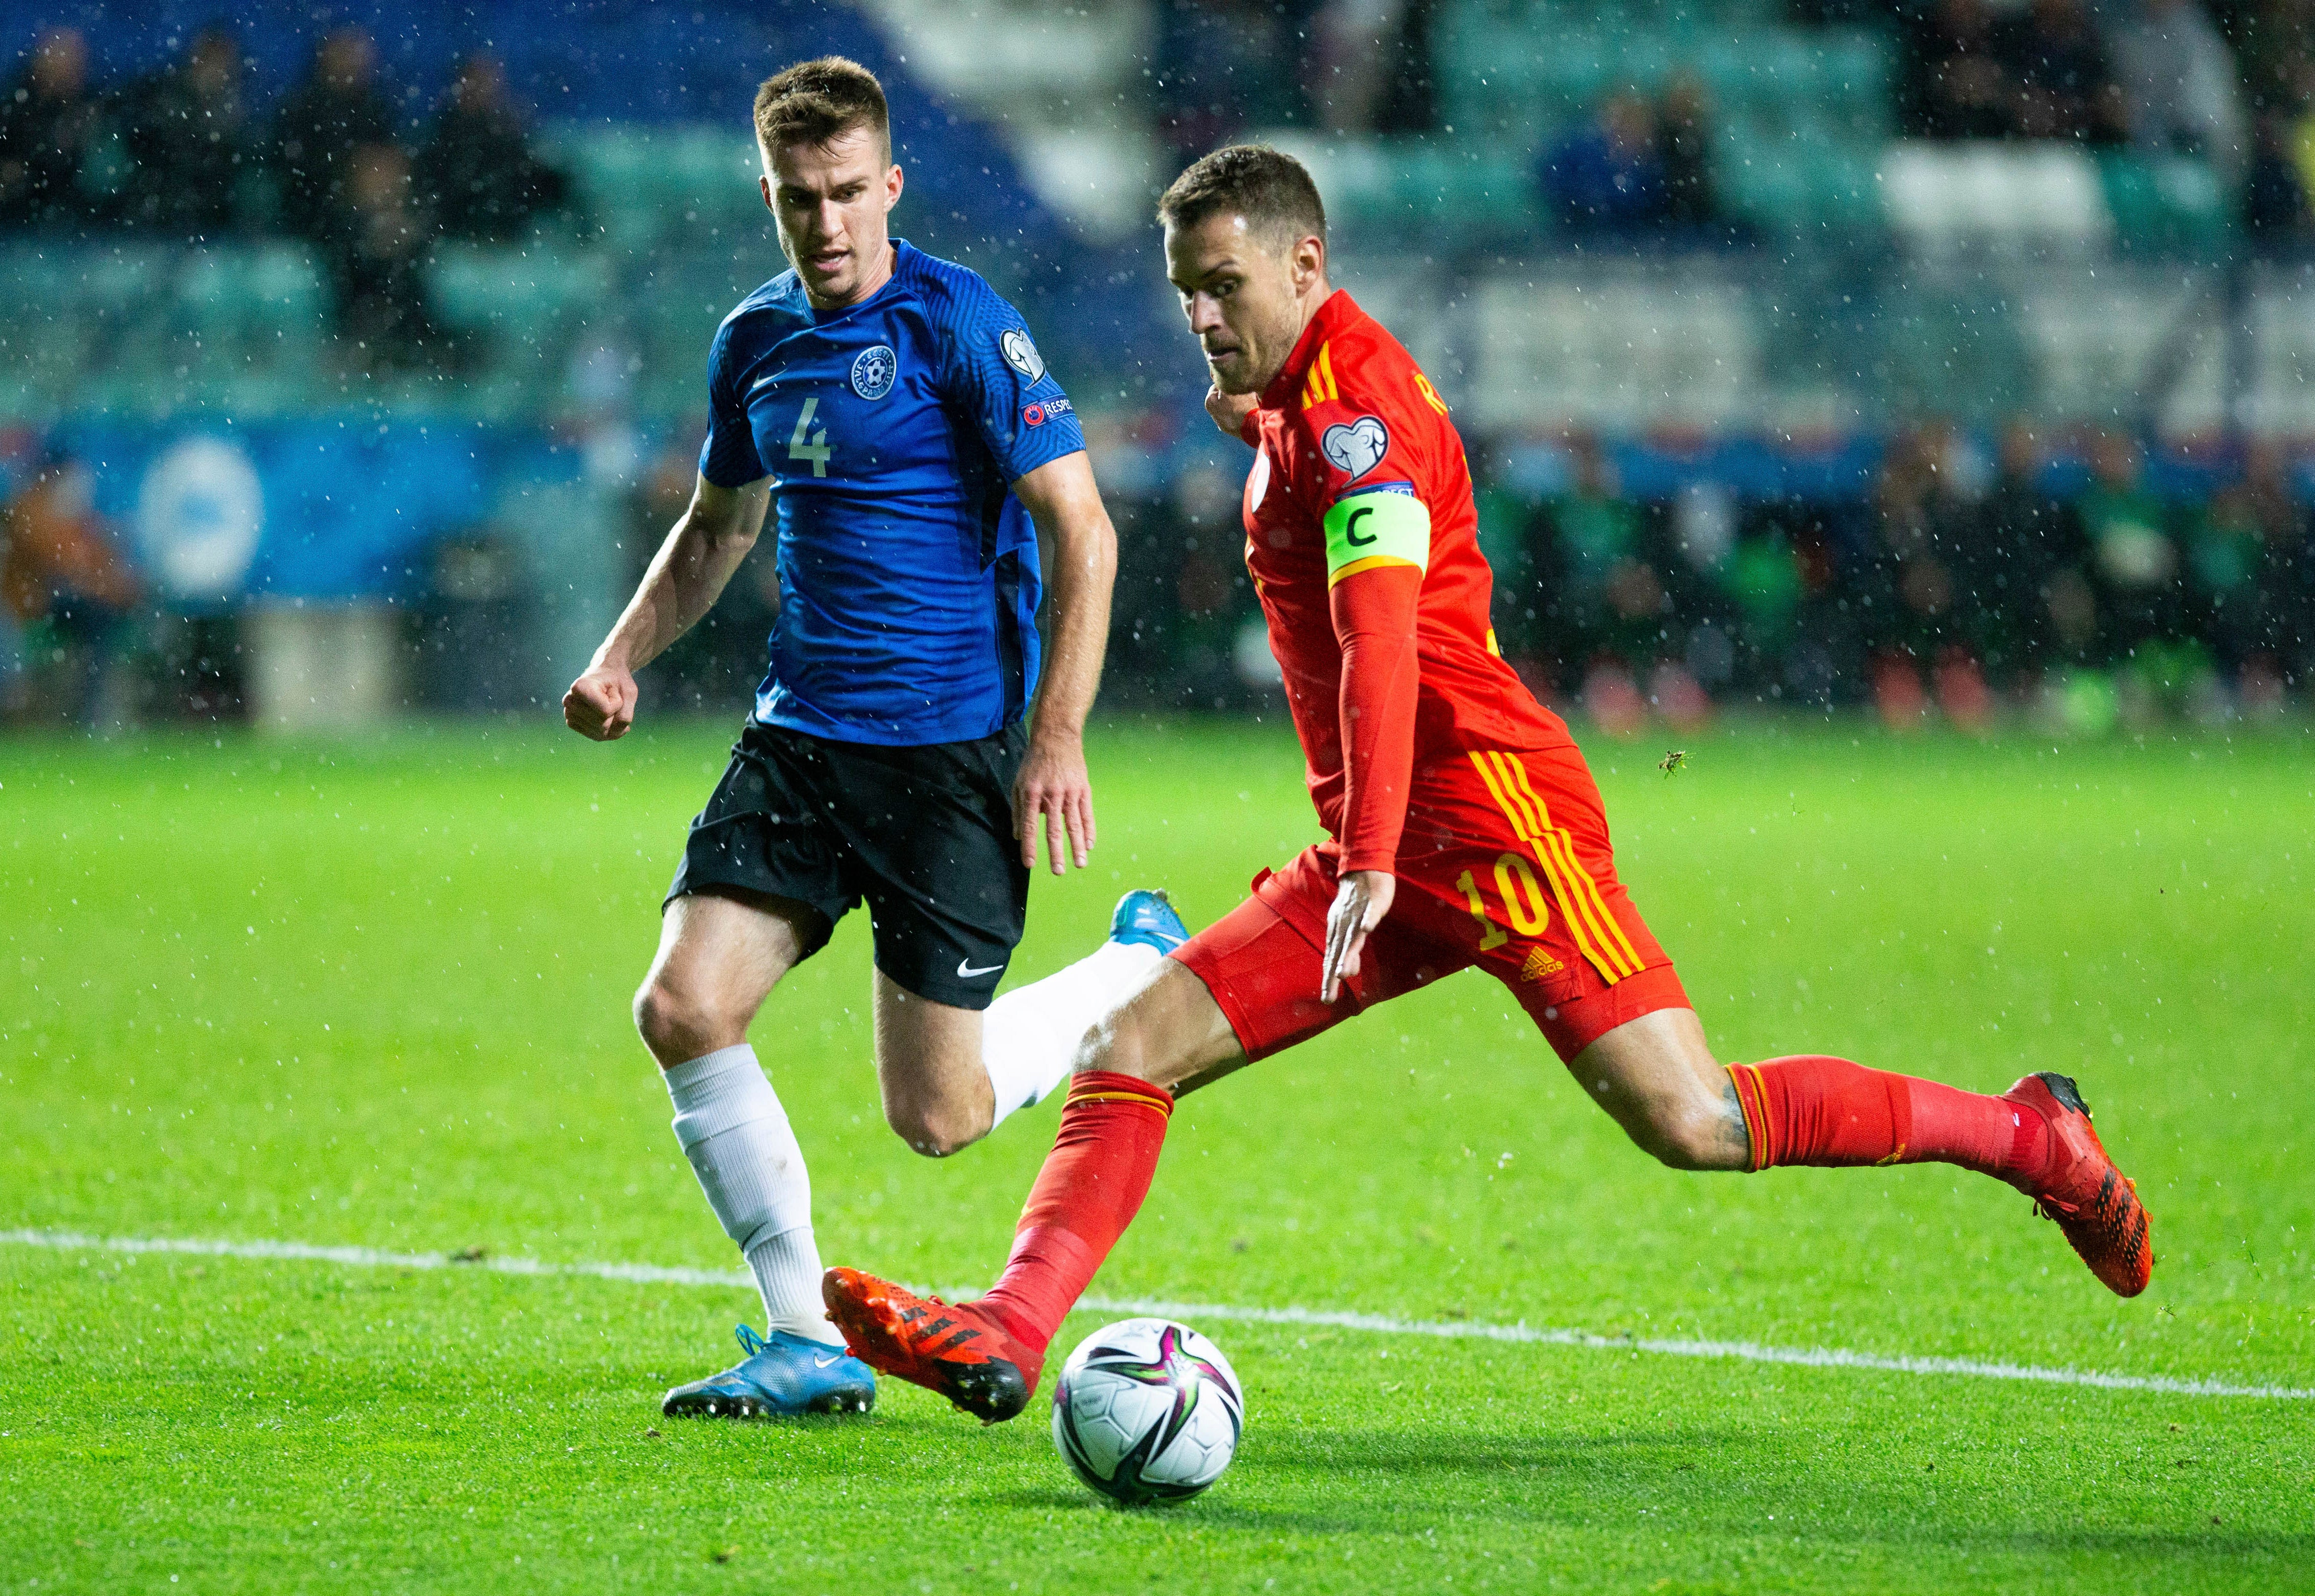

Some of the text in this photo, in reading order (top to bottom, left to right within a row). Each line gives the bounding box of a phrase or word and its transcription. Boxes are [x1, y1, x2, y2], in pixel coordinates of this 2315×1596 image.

[1414, 373, 1448, 416] R
[788, 397, 831, 478] 4
[1346, 507, 1377, 547] C
[1456, 853, 1549, 952] 10
[1521, 961, 1564, 982] adidas
